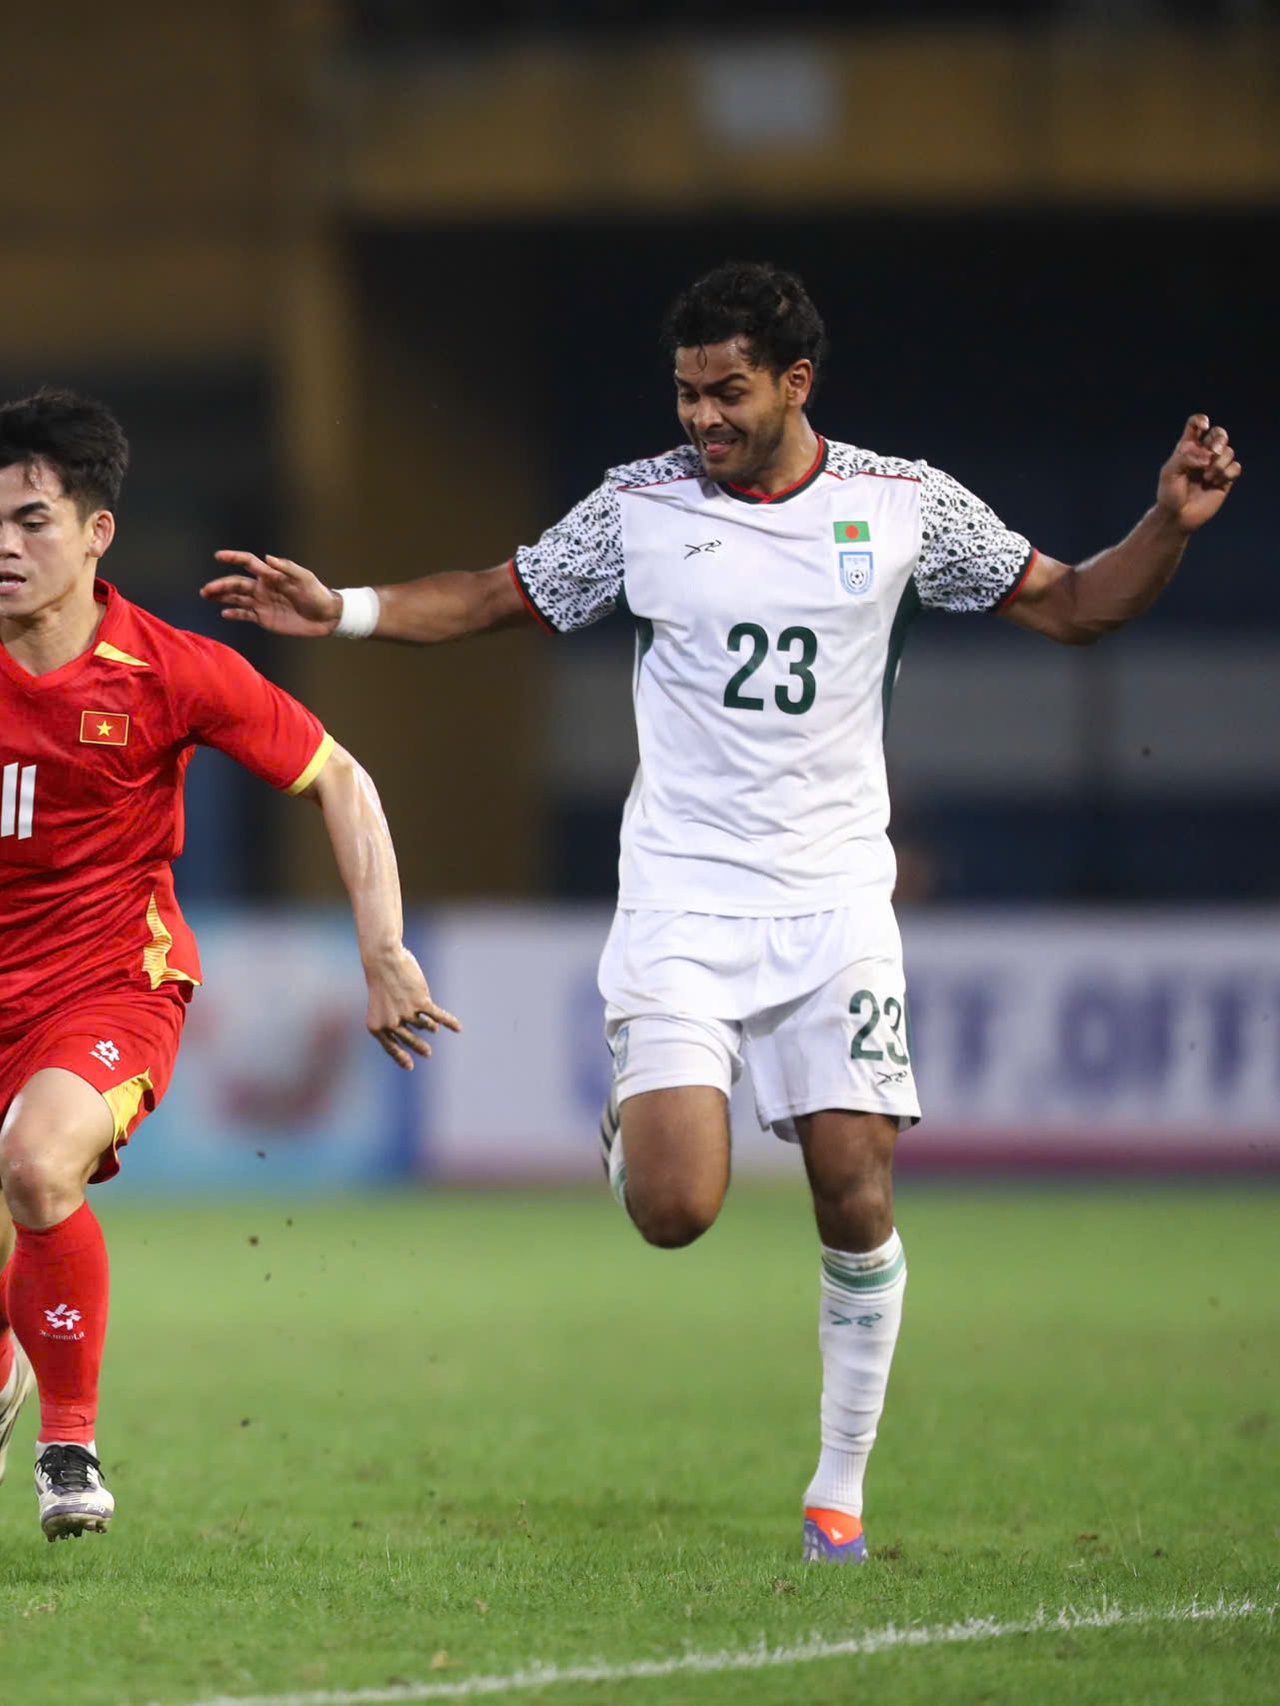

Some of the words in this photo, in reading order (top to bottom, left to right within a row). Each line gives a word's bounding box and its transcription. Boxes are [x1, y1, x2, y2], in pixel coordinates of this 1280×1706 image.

[723, 622, 818, 716] 23
[0, 762, 37, 840] 11
[849, 989, 909, 1066] 23
